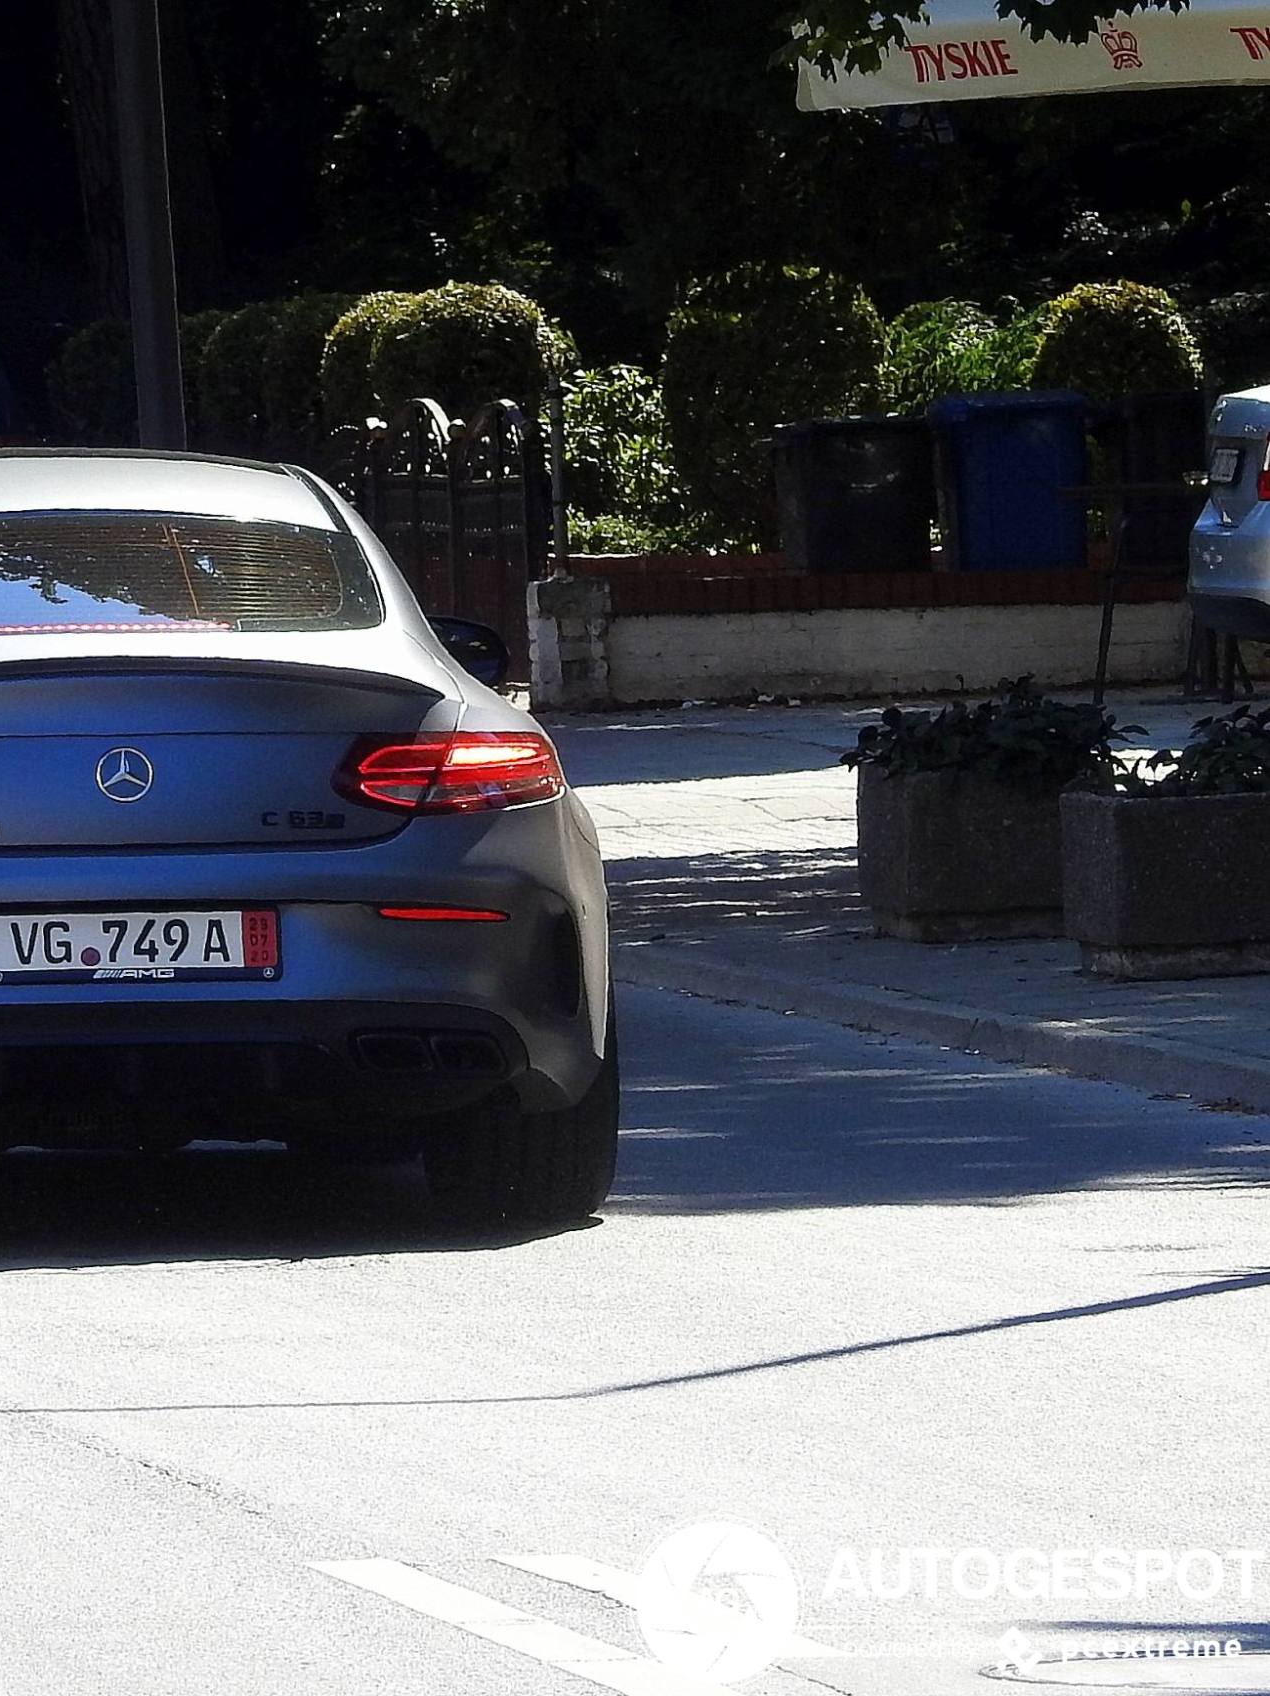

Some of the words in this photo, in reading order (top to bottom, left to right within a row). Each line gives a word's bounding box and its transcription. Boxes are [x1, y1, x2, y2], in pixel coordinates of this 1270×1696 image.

[904, 39, 1018, 83] TYSKIE
[261, 811, 279, 827] C
[10, 920, 72, 965] VG
[102, 918, 190, 964] 749
[202, 917, 230, 963] A
[249, 933, 268, 947] 07
[118, 968, 175, 979] AMG
